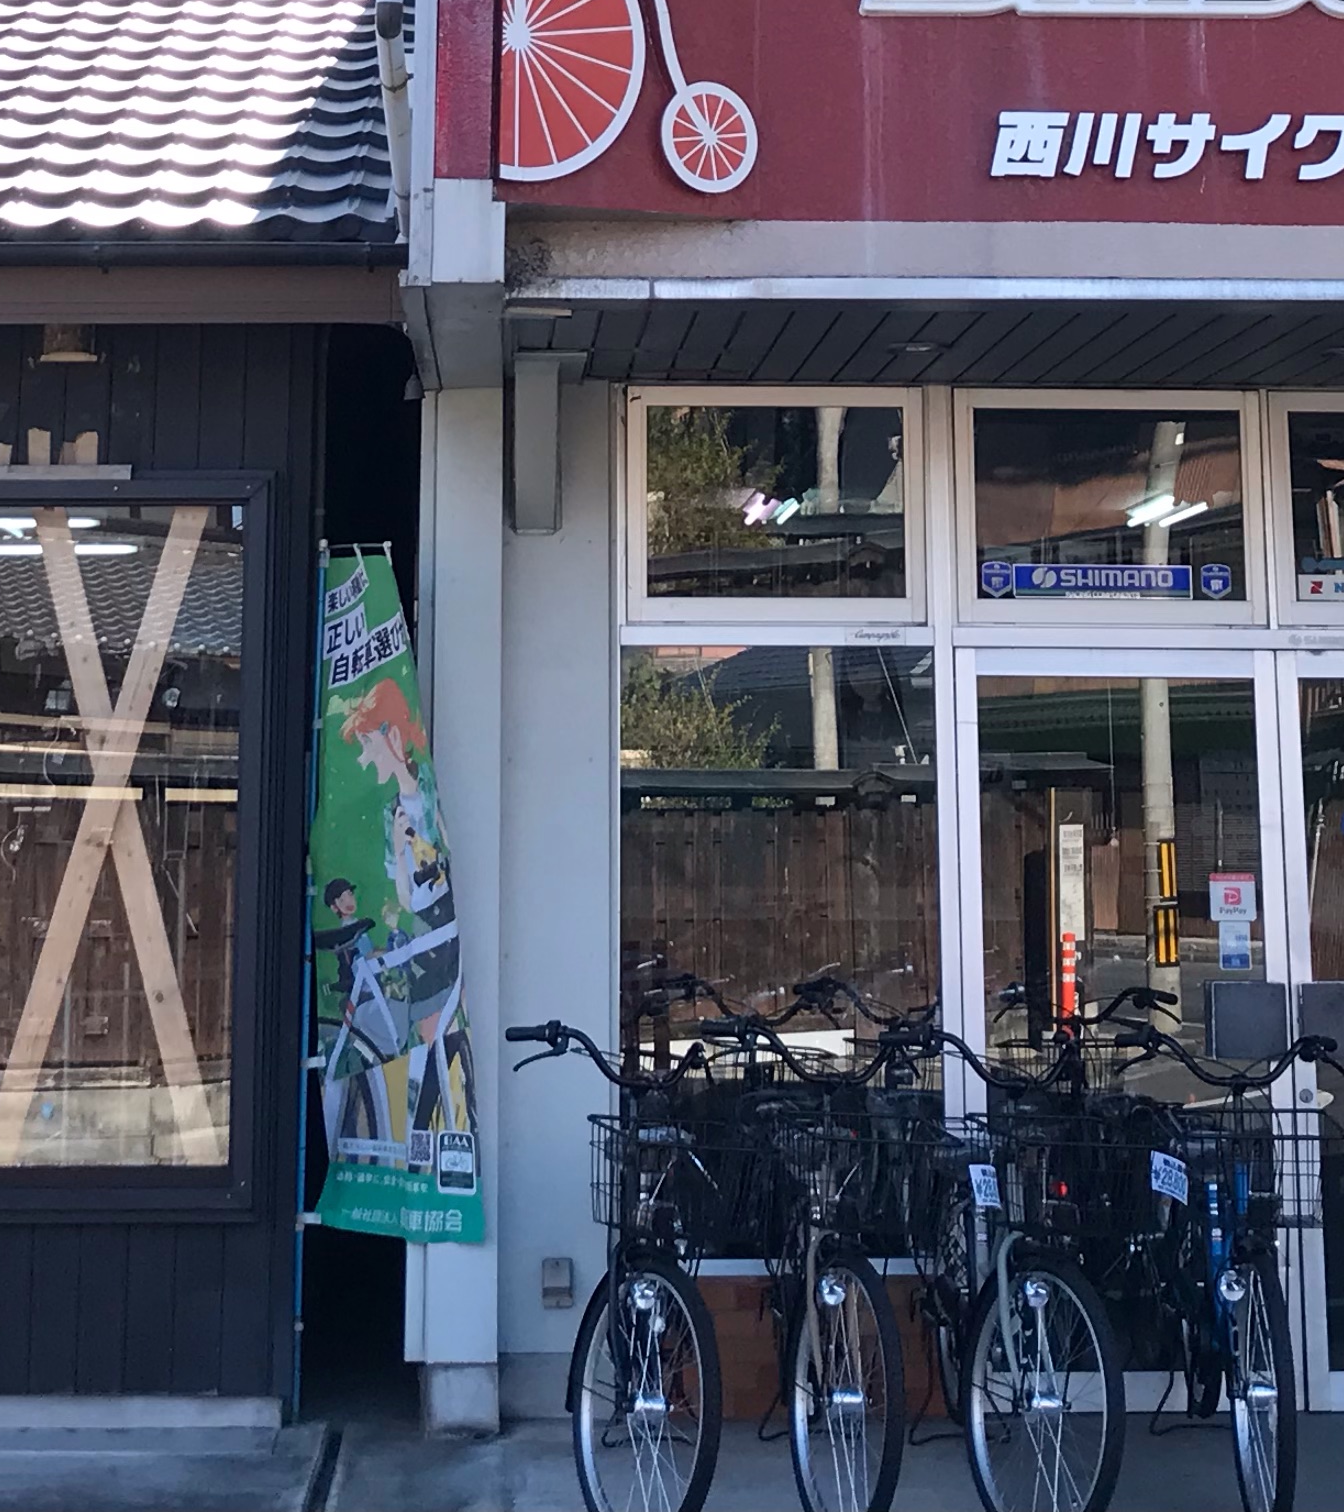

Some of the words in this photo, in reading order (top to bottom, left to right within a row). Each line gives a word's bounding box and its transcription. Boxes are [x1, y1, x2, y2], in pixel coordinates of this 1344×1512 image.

[1060, 569, 1174, 588] SHIMANO
[327, 611, 366, 654] 正しい
[1219, 906, 1247, 916] PayPay
